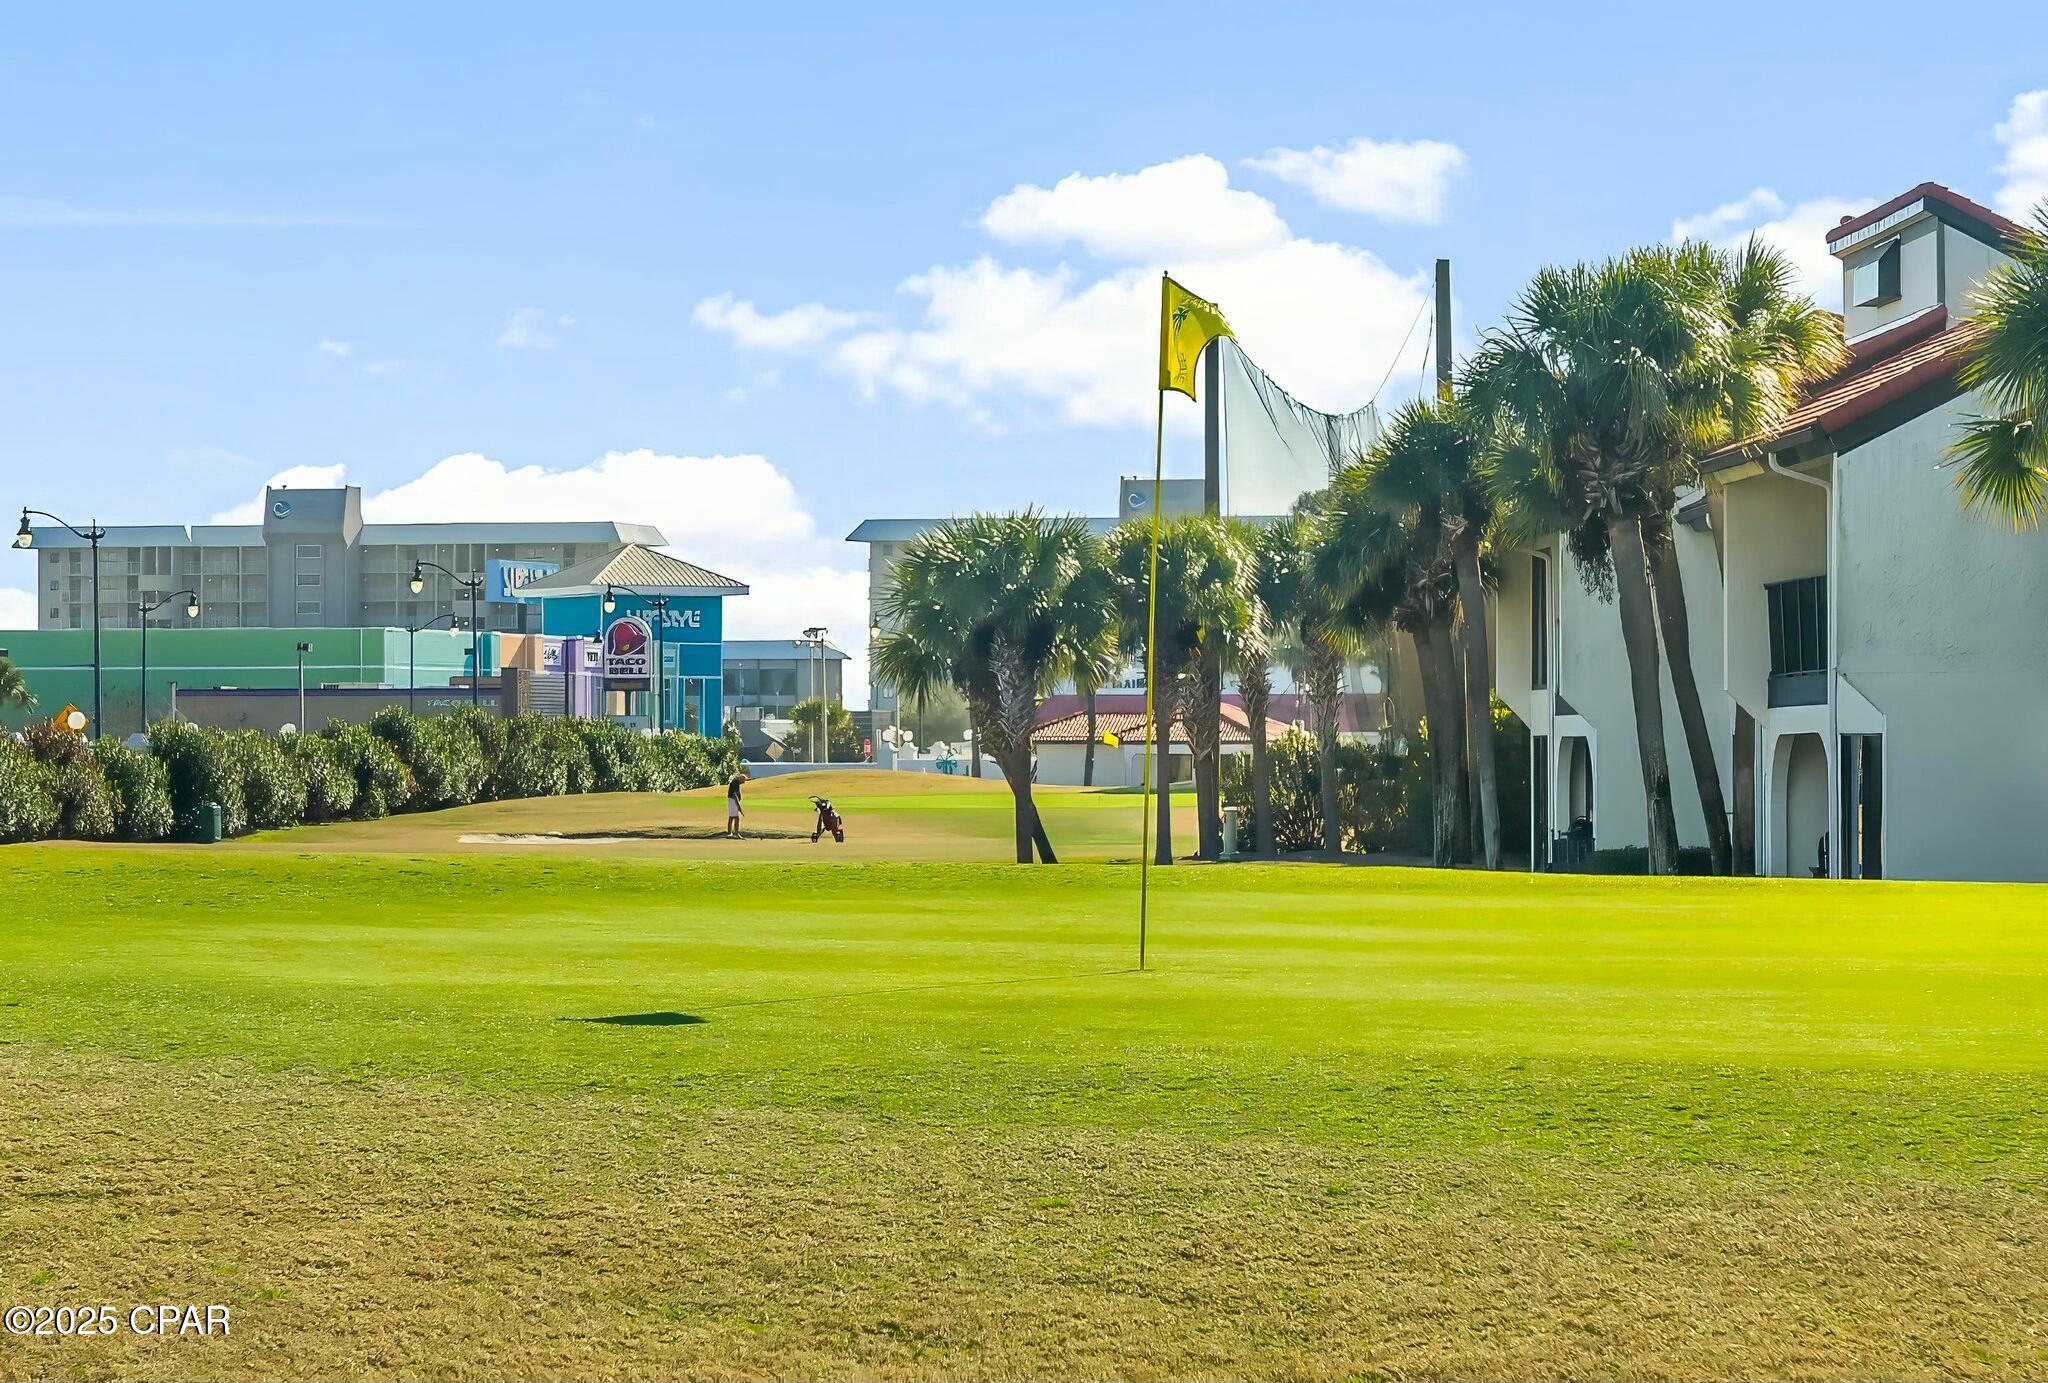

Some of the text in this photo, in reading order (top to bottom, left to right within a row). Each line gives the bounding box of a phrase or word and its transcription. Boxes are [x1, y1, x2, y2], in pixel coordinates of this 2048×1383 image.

[606, 657, 646, 666] TACO
[608, 667, 647, 675] BELL
[462, 699, 499, 707] BLL
